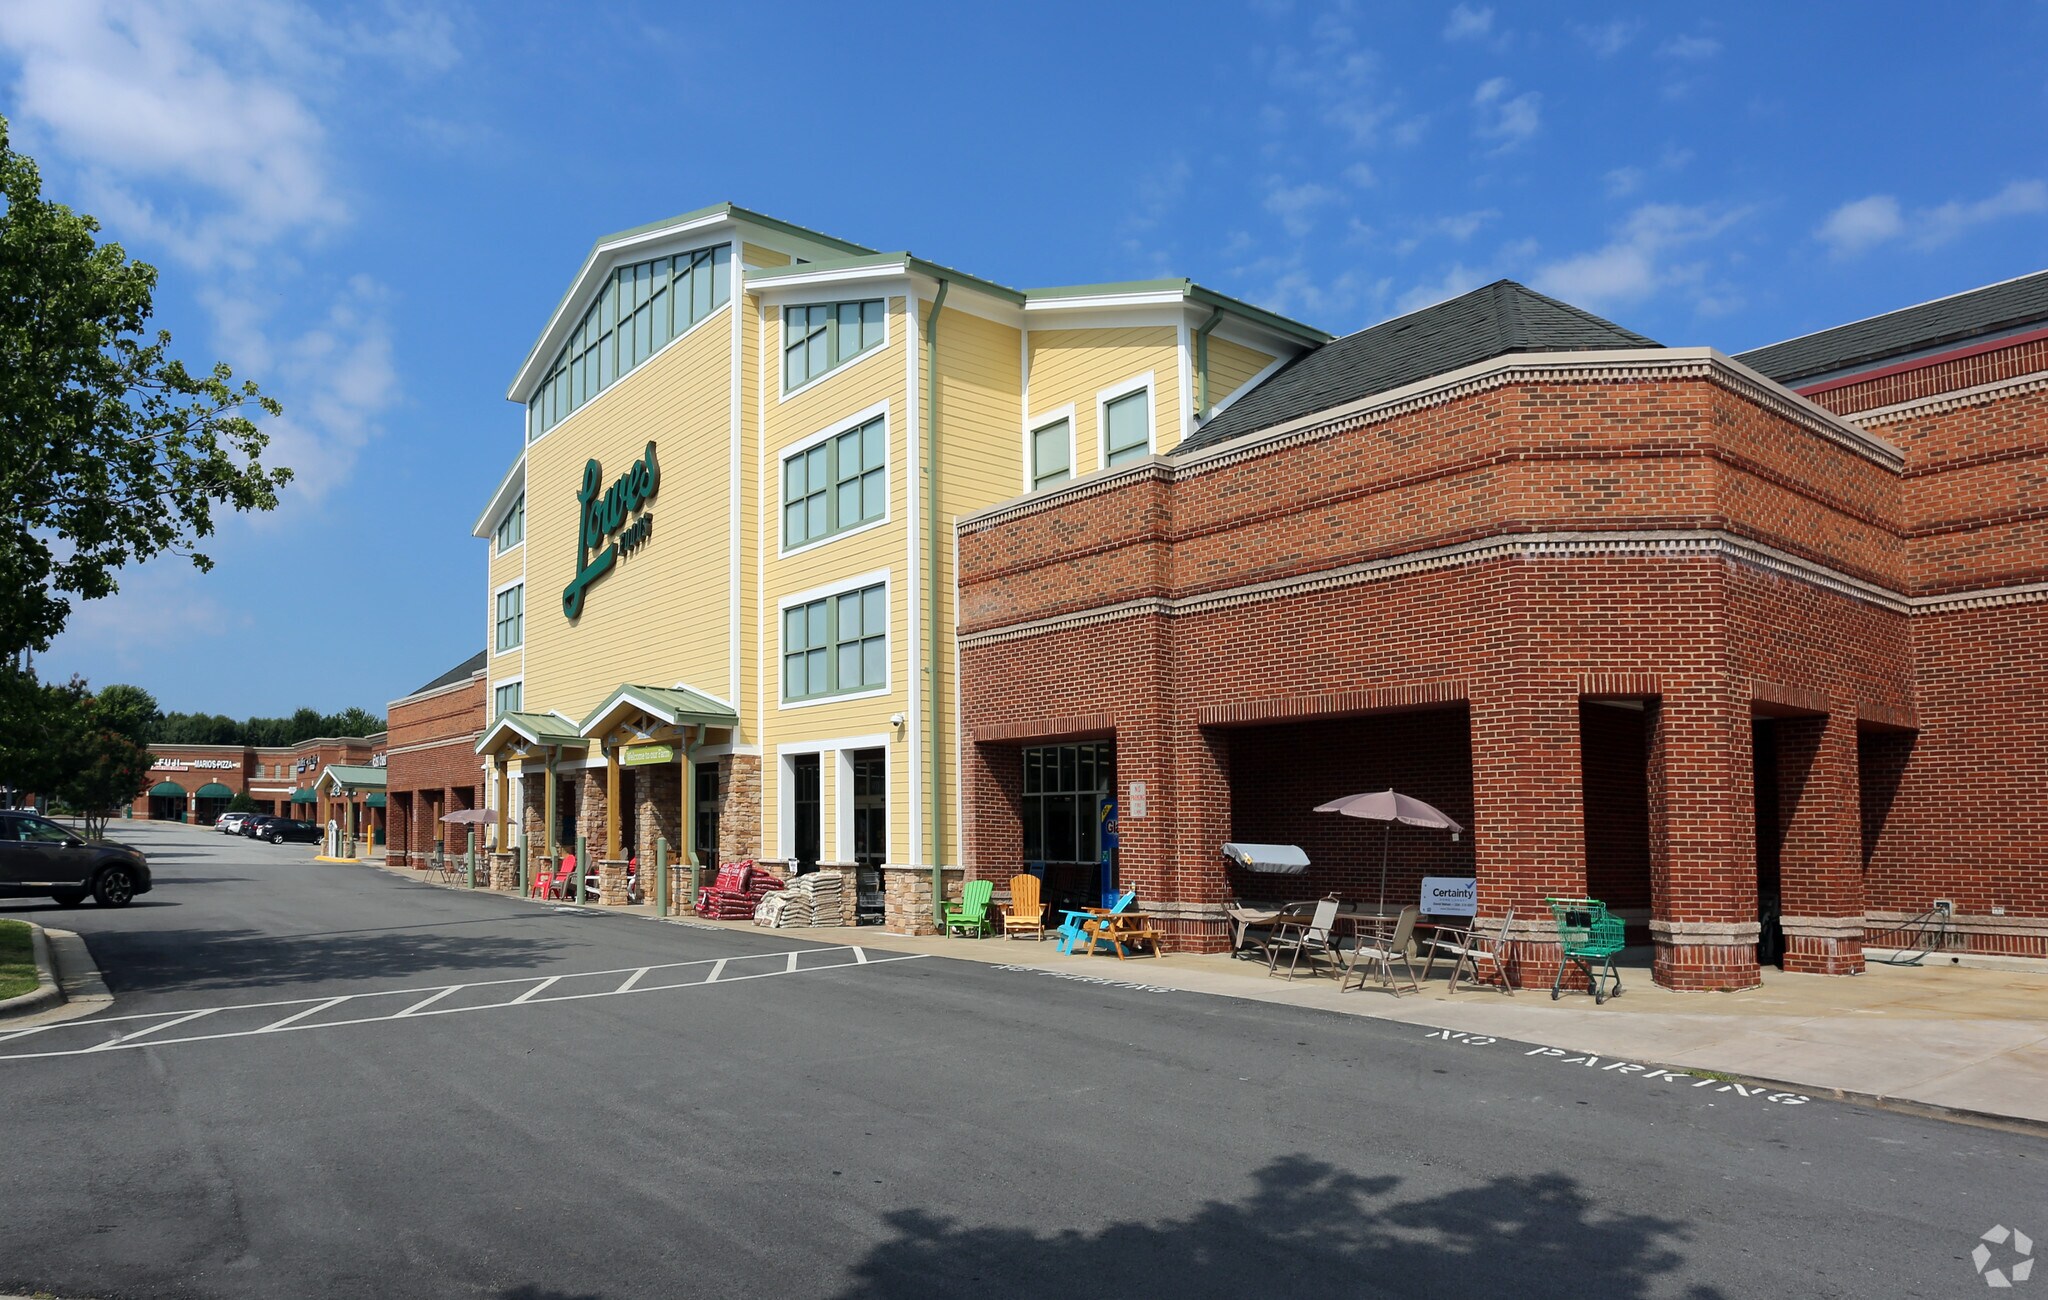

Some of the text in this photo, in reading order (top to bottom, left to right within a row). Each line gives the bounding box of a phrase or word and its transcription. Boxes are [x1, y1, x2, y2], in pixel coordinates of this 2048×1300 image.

[1432, 888, 1474, 899] Certainty
[1424, 1029, 1811, 1105] NO PARKING
